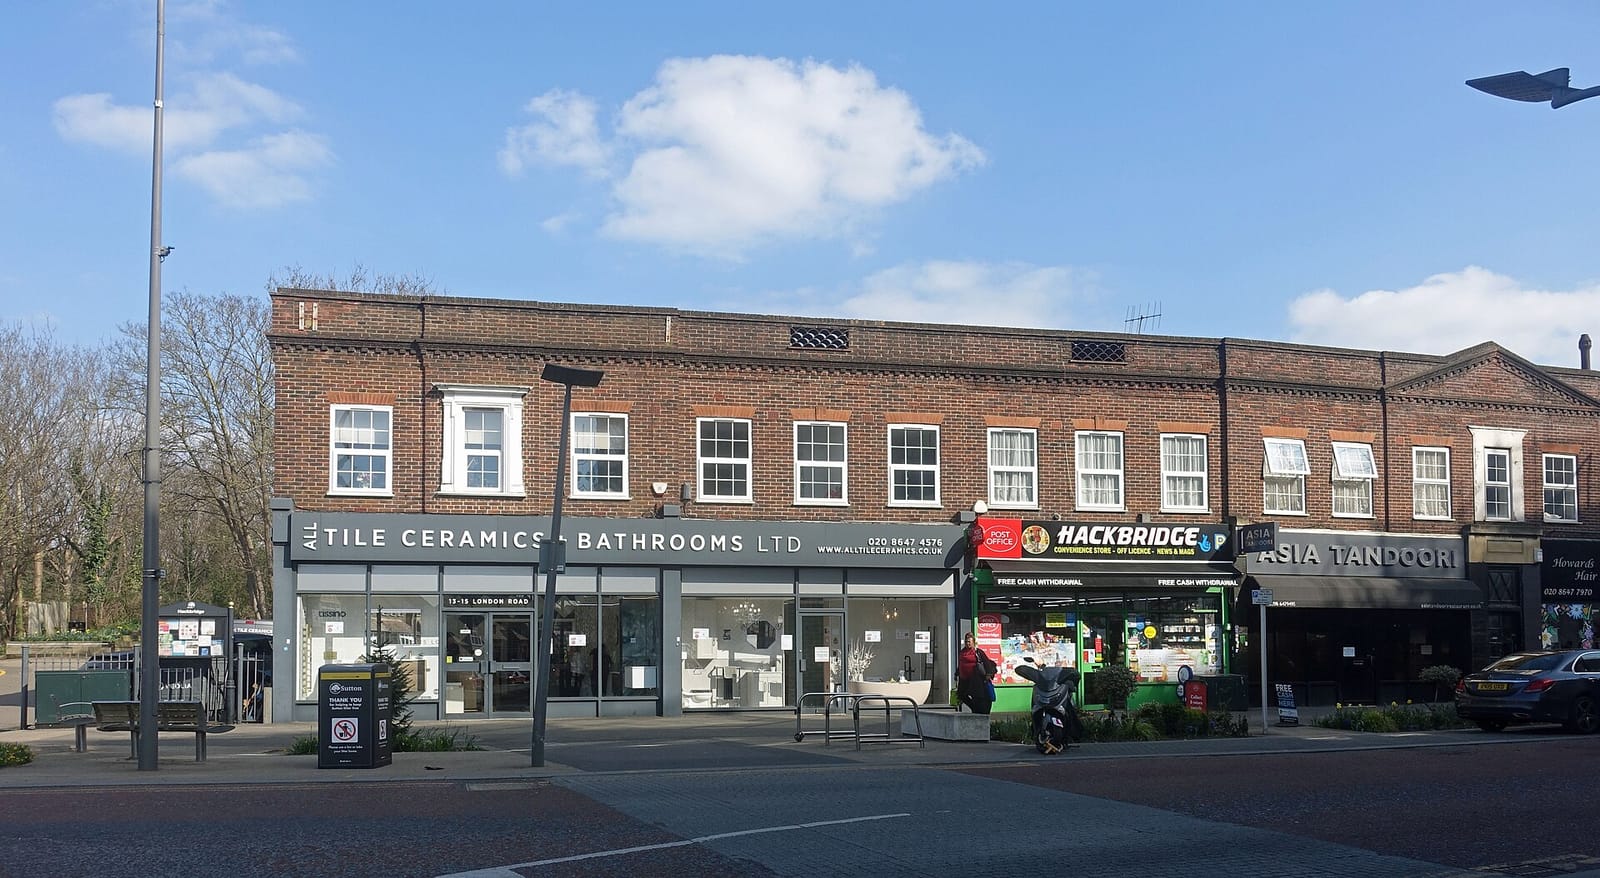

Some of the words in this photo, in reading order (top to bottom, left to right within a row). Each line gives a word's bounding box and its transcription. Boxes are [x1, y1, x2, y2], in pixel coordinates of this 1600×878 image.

[303, 522, 317, 550] ALL
[324, 528, 386, 546] TILE
[402, 530, 544, 548] CERAMICS
[578, 532, 744, 551] BATHROOMS
[757, 535, 801, 552] LTD
[1056, 525, 1200, 546] HACKBRIDGE
[1246, 528, 1270, 540] ASIA
[868, 537, 887, 546] 020
[891, 538, 915, 546] 8647
[919, 538, 943, 547] 4576
[817, 546, 943, 555] WWW.ALLTILECERAMICS.CO.UK
[1128, 547, 1151, 555] LICENCE
[1256, 543, 1321, 564] ASIA
[1329, 544, 1460, 568] TANDOORI
[1552, 556, 1595, 569] Howards
[1574, 570, 1598, 581] Hair
[1543, 588, 1557, 596] 020
[1275, 684, 1292, 692] FREE
